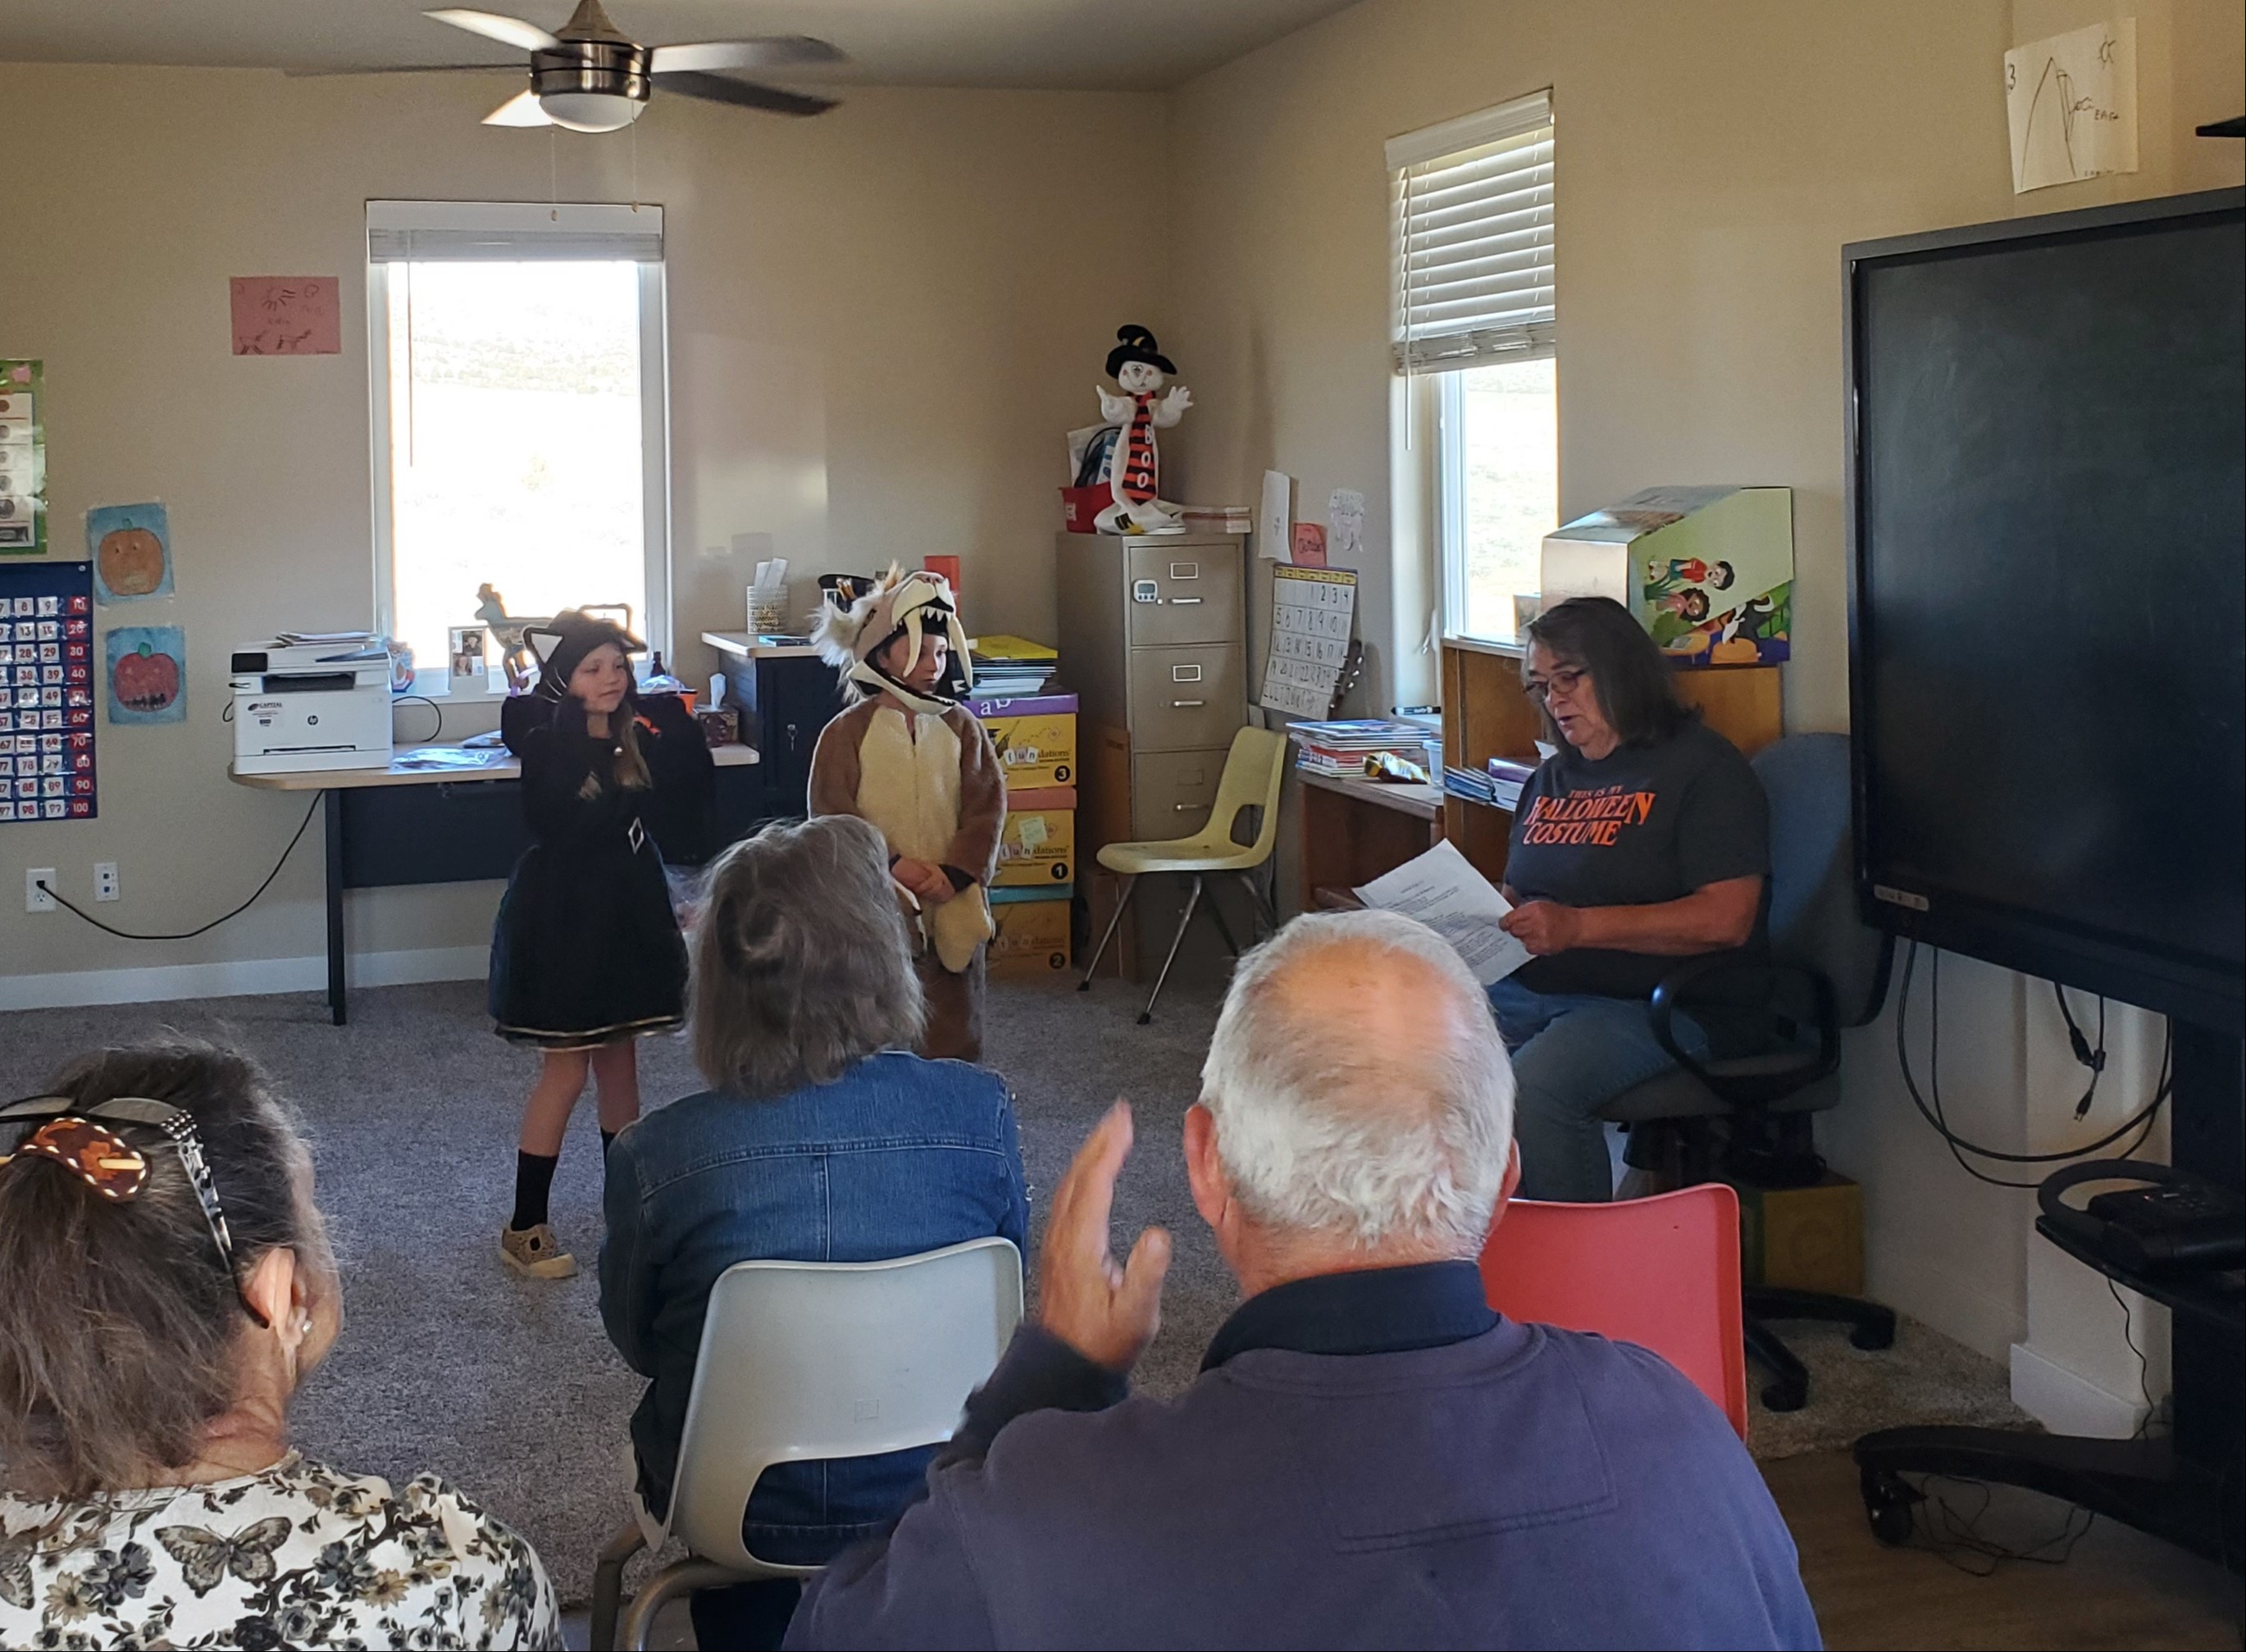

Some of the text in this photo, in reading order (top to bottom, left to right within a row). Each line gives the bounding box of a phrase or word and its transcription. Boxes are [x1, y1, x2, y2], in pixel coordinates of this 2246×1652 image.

[1320, 585, 1326, 601] 2
[1332, 587, 1337, 603] 3
[21, 602, 28, 612] 8
[45, 601, 51, 612] 9
[74, 599, 85, 611] 10
[1276, 608, 1282, 624] 5
[1285, 609, 1291, 627] 6
[1297, 609, 1303, 625] 7
[1308, 611, 1312, 630] 8
[1319, 611, 1323, 629] 9
[69, 624, 85, 635] 20
[19, 649, 32, 658] 28
[44, 647, 56, 658] 29
[70, 646, 84, 656] 30
[1305, 640, 1312, 657] 15
[1327, 644, 1333, 659] 17
[21, 668, 86, 680] 38 39 40
[45, 691, 58, 700] 49
[72, 712, 87, 723] 60
[0, 740, 11, 749] 67
[73, 737, 86, 747] 70
[22, 761, 34, 770] 78
[77, 757, 90, 767] 80
[1058, 768, 1067, 780] 3
[22, 783, 34, 792] 88
[48, 781, 61, 791] 89
[76, 780, 90, 790] 90
[1568, 784, 1624, 798] THIS IS MY
[0, 806, 11, 817] 97
[22, 805, 34, 814] 98
[73, 803, 89, 812] 100
[1524, 792, 1656, 825] HALLOWEEN
[1523, 820, 1622, 845] COSTUME
[1056, 865, 1064, 877] 1
[1052, 954, 1062, 967] 2
